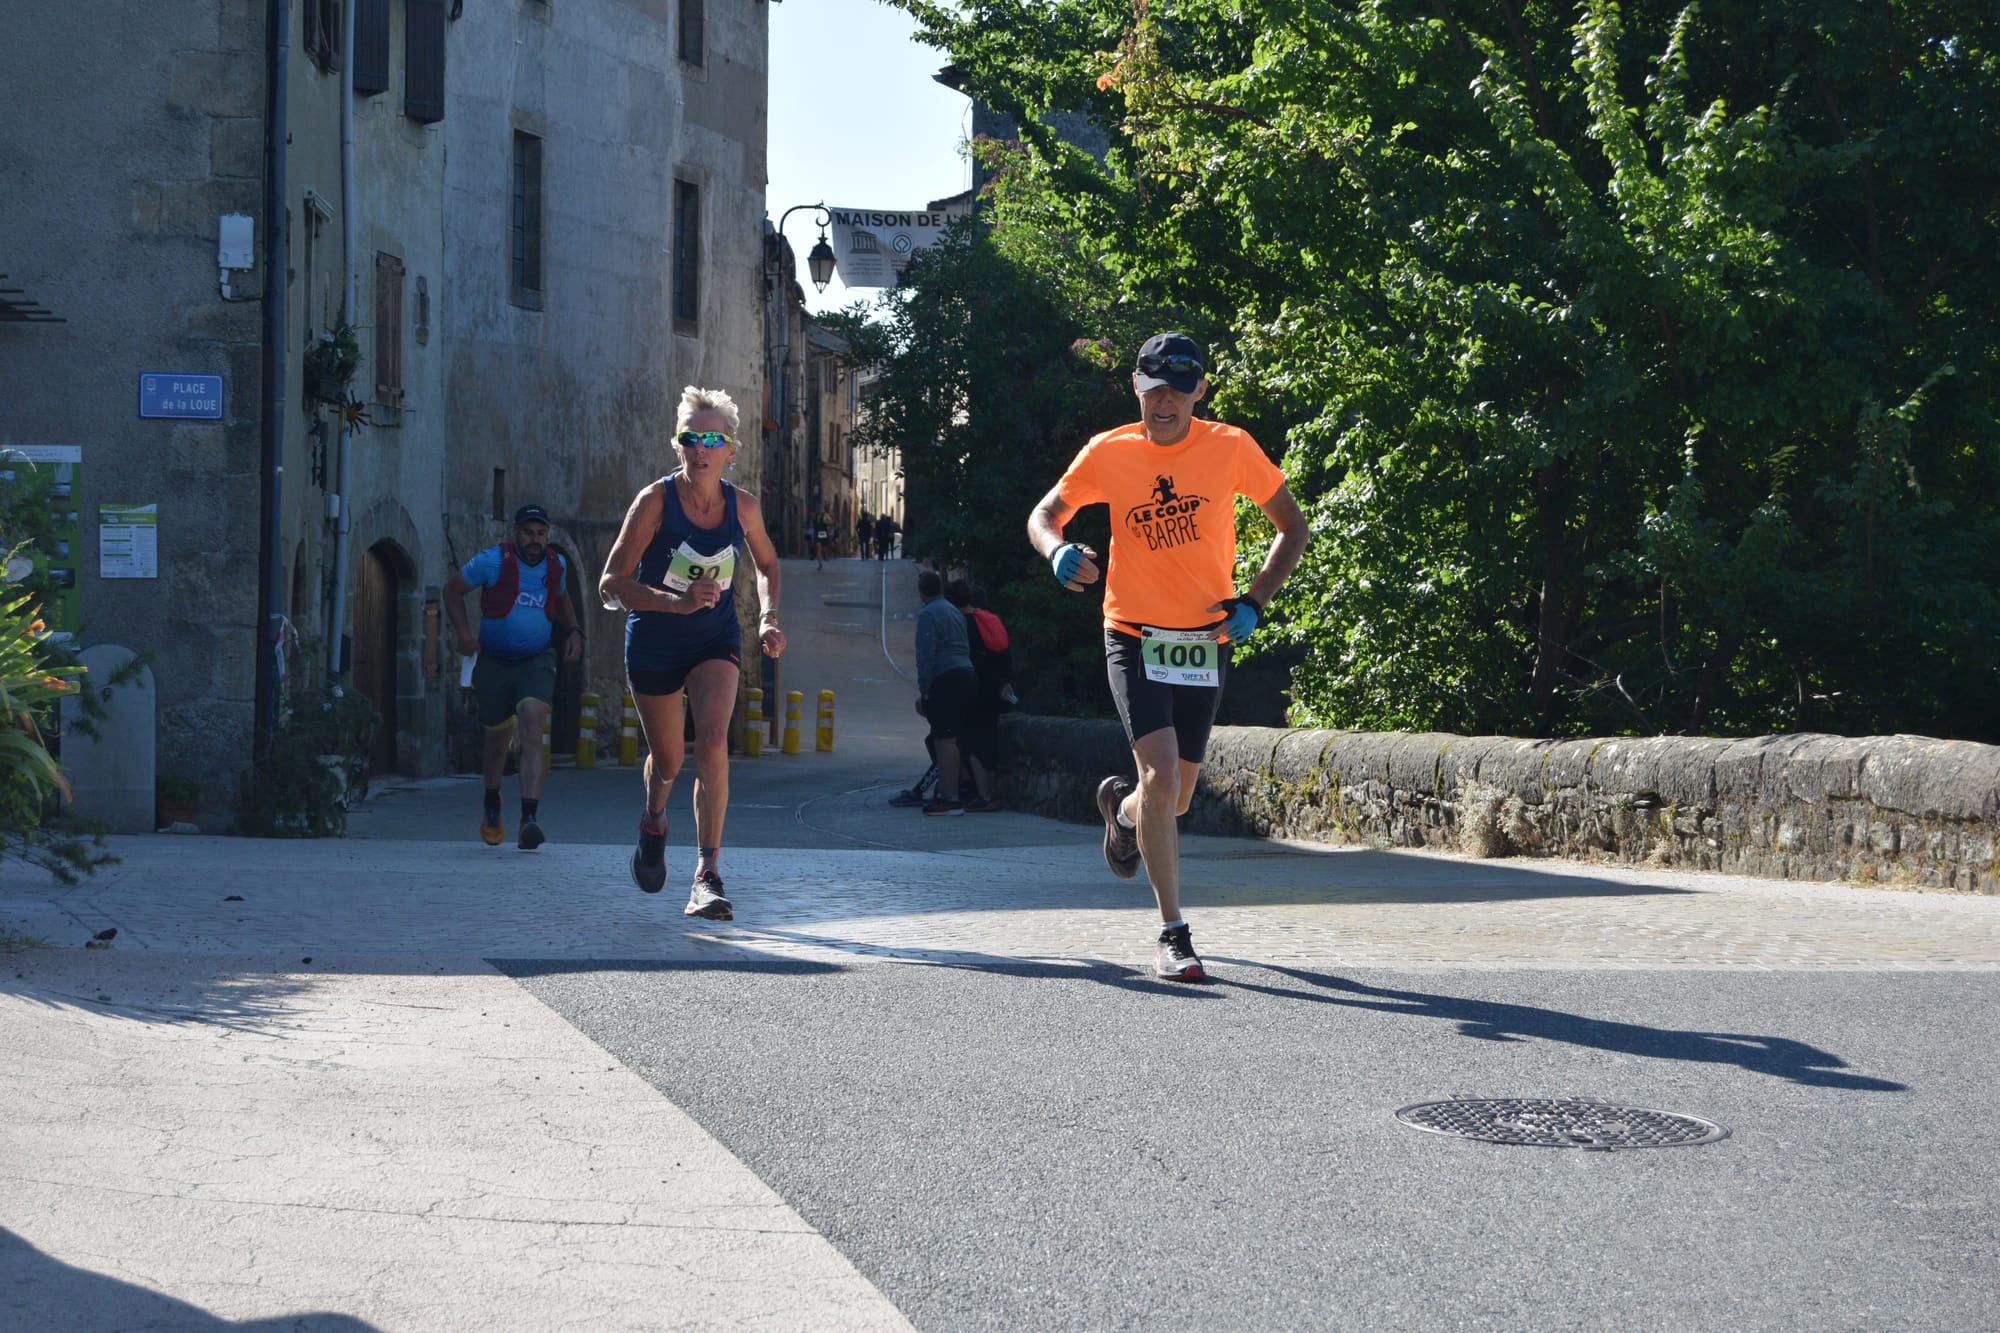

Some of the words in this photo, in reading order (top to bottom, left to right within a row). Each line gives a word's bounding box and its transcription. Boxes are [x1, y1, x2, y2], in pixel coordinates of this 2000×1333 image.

[836, 212, 911, 227] MAISON
[918, 214, 941, 227] DE
[173, 383, 206, 394] PLACE
[162, 399, 174, 409] de
[177, 400, 186, 410] la
[190, 400, 217, 410] LOUE
[1133, 510, 1152, 523] LE
[1155, 500, 1200, 518] COUP
[1142, 513, 1201, 551] BARRE
[1153, 644, 1206, 668] 100
